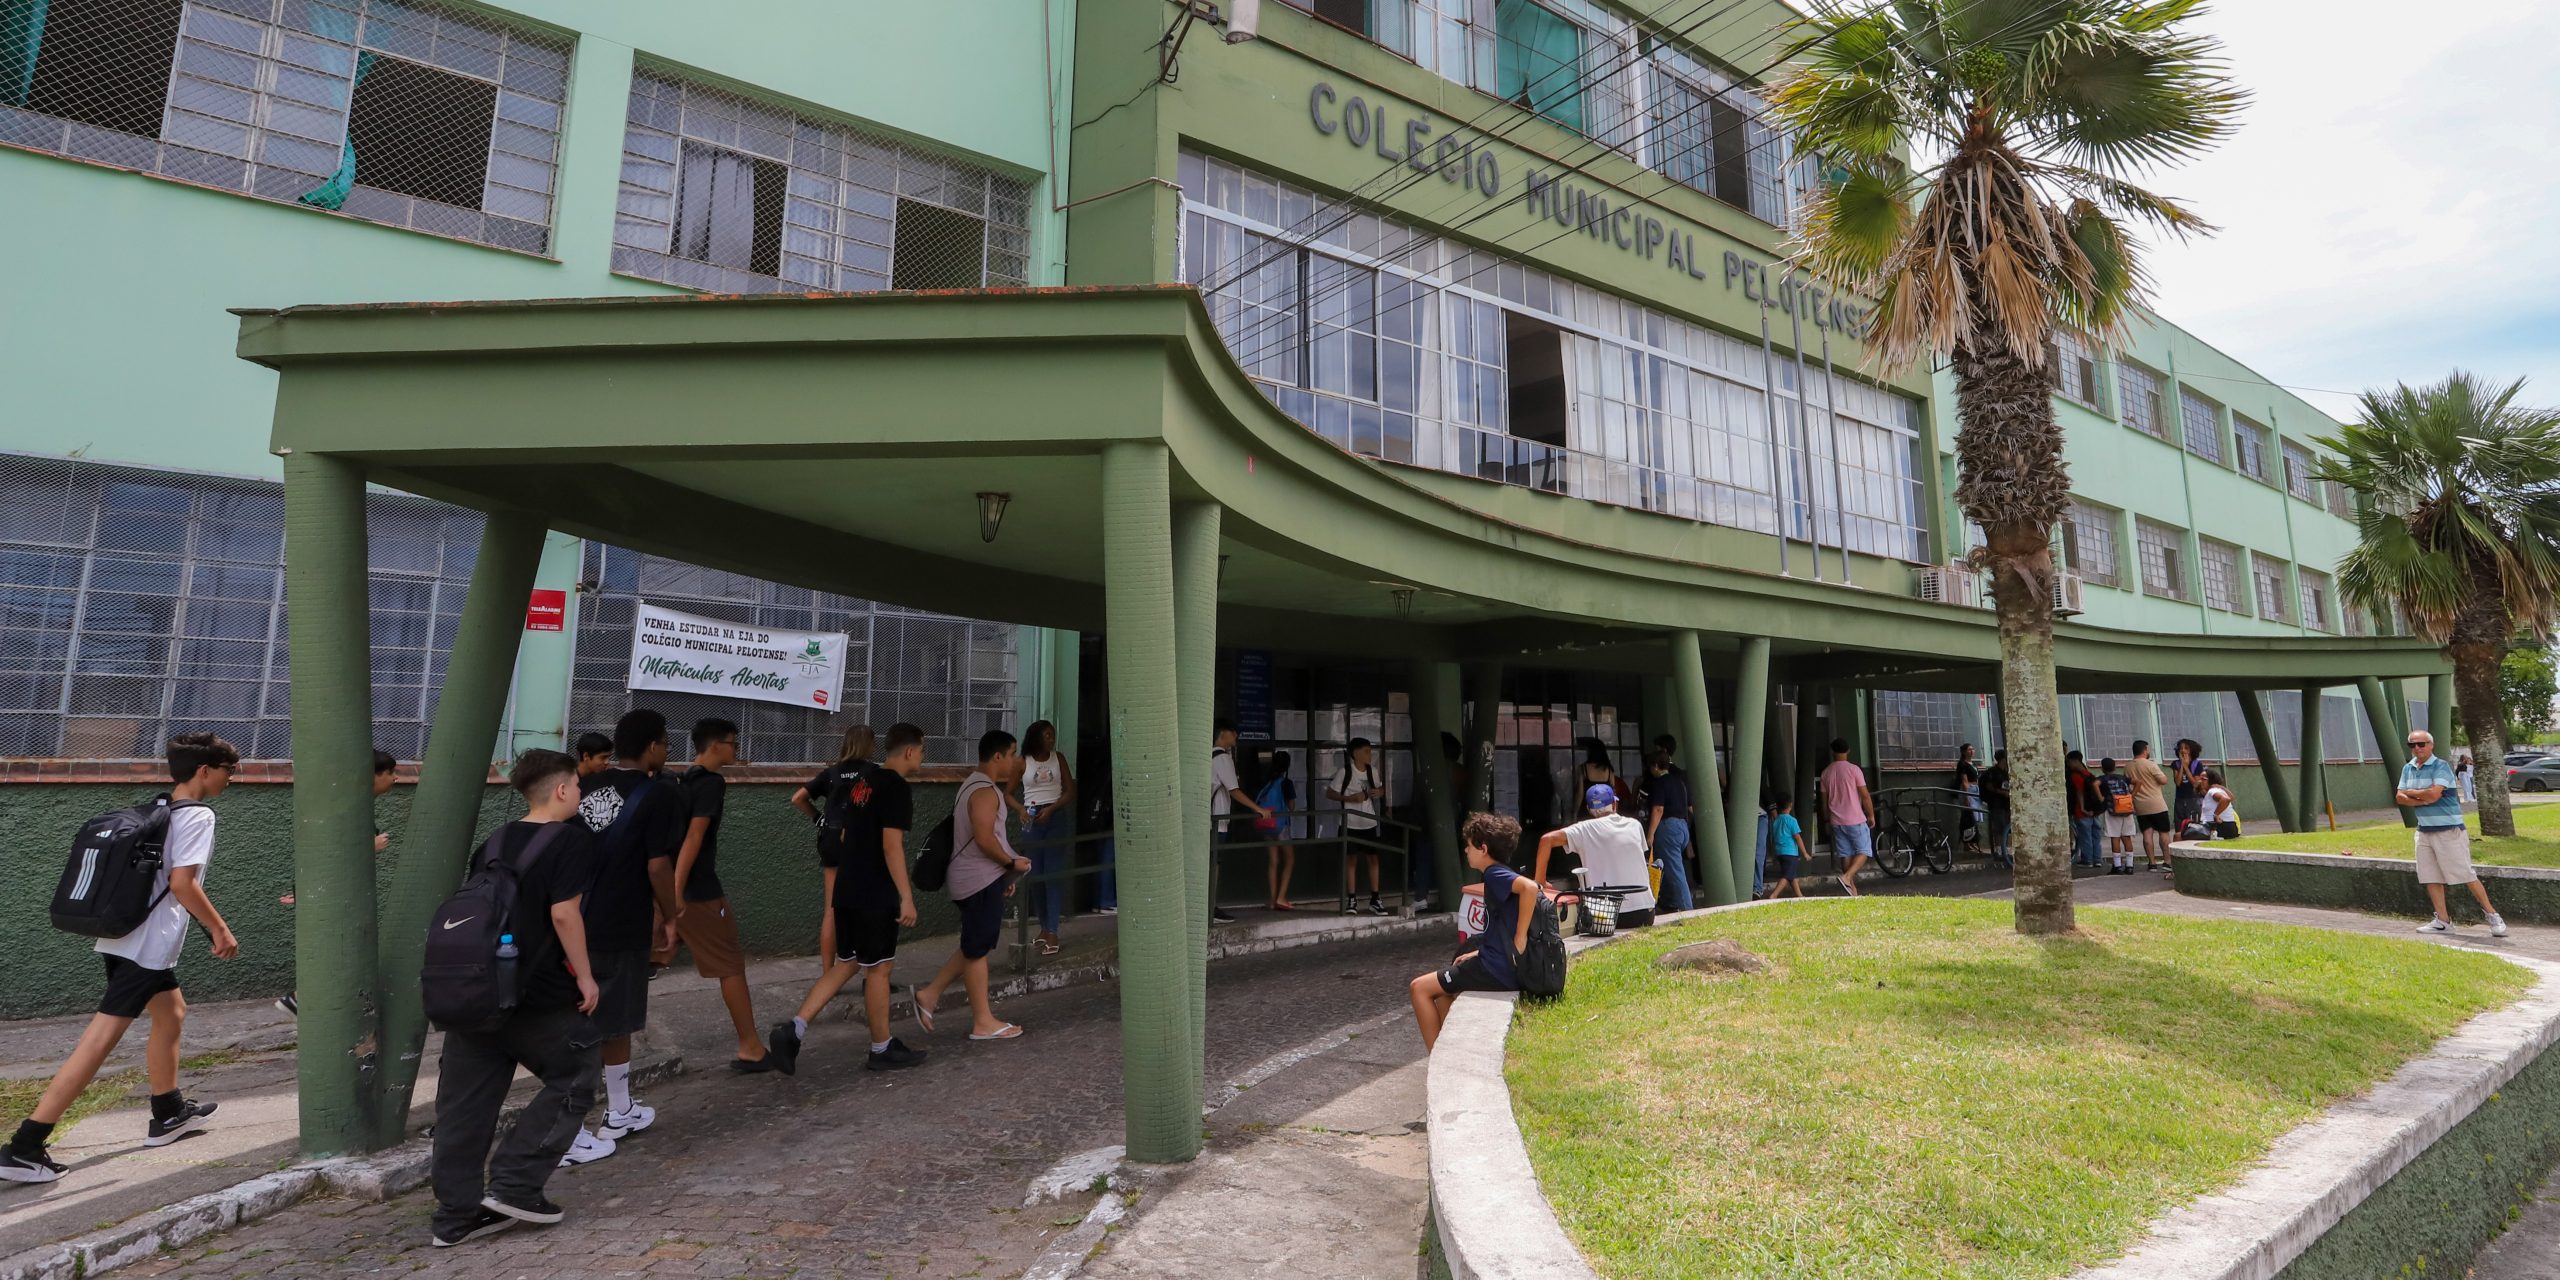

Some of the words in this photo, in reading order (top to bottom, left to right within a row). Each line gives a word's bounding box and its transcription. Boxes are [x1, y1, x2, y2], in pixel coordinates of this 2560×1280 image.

[1311, 82, 1500, 198] COLÉGIO
[1527, 168, 1706, 281] MUNICIPAL
[644, 617, 675, 631] VENHA
[679, 622, 719, 637] ESTUDAR
[723, 628, 735, 640] NA
[738, 630, 754, 642] EJA
[757, 633, 770, 644] DO
[641, 632, 682, 648] COLÉGIO
[685, 639, 733, 655] MUNICIPAL
[736, 645, 788, 661] PELOTENSE!
[638, 654, 725, 684] Matrículas
[730, 666, 790, 691] Abertas
[801, 664, 820, 675] EJA
